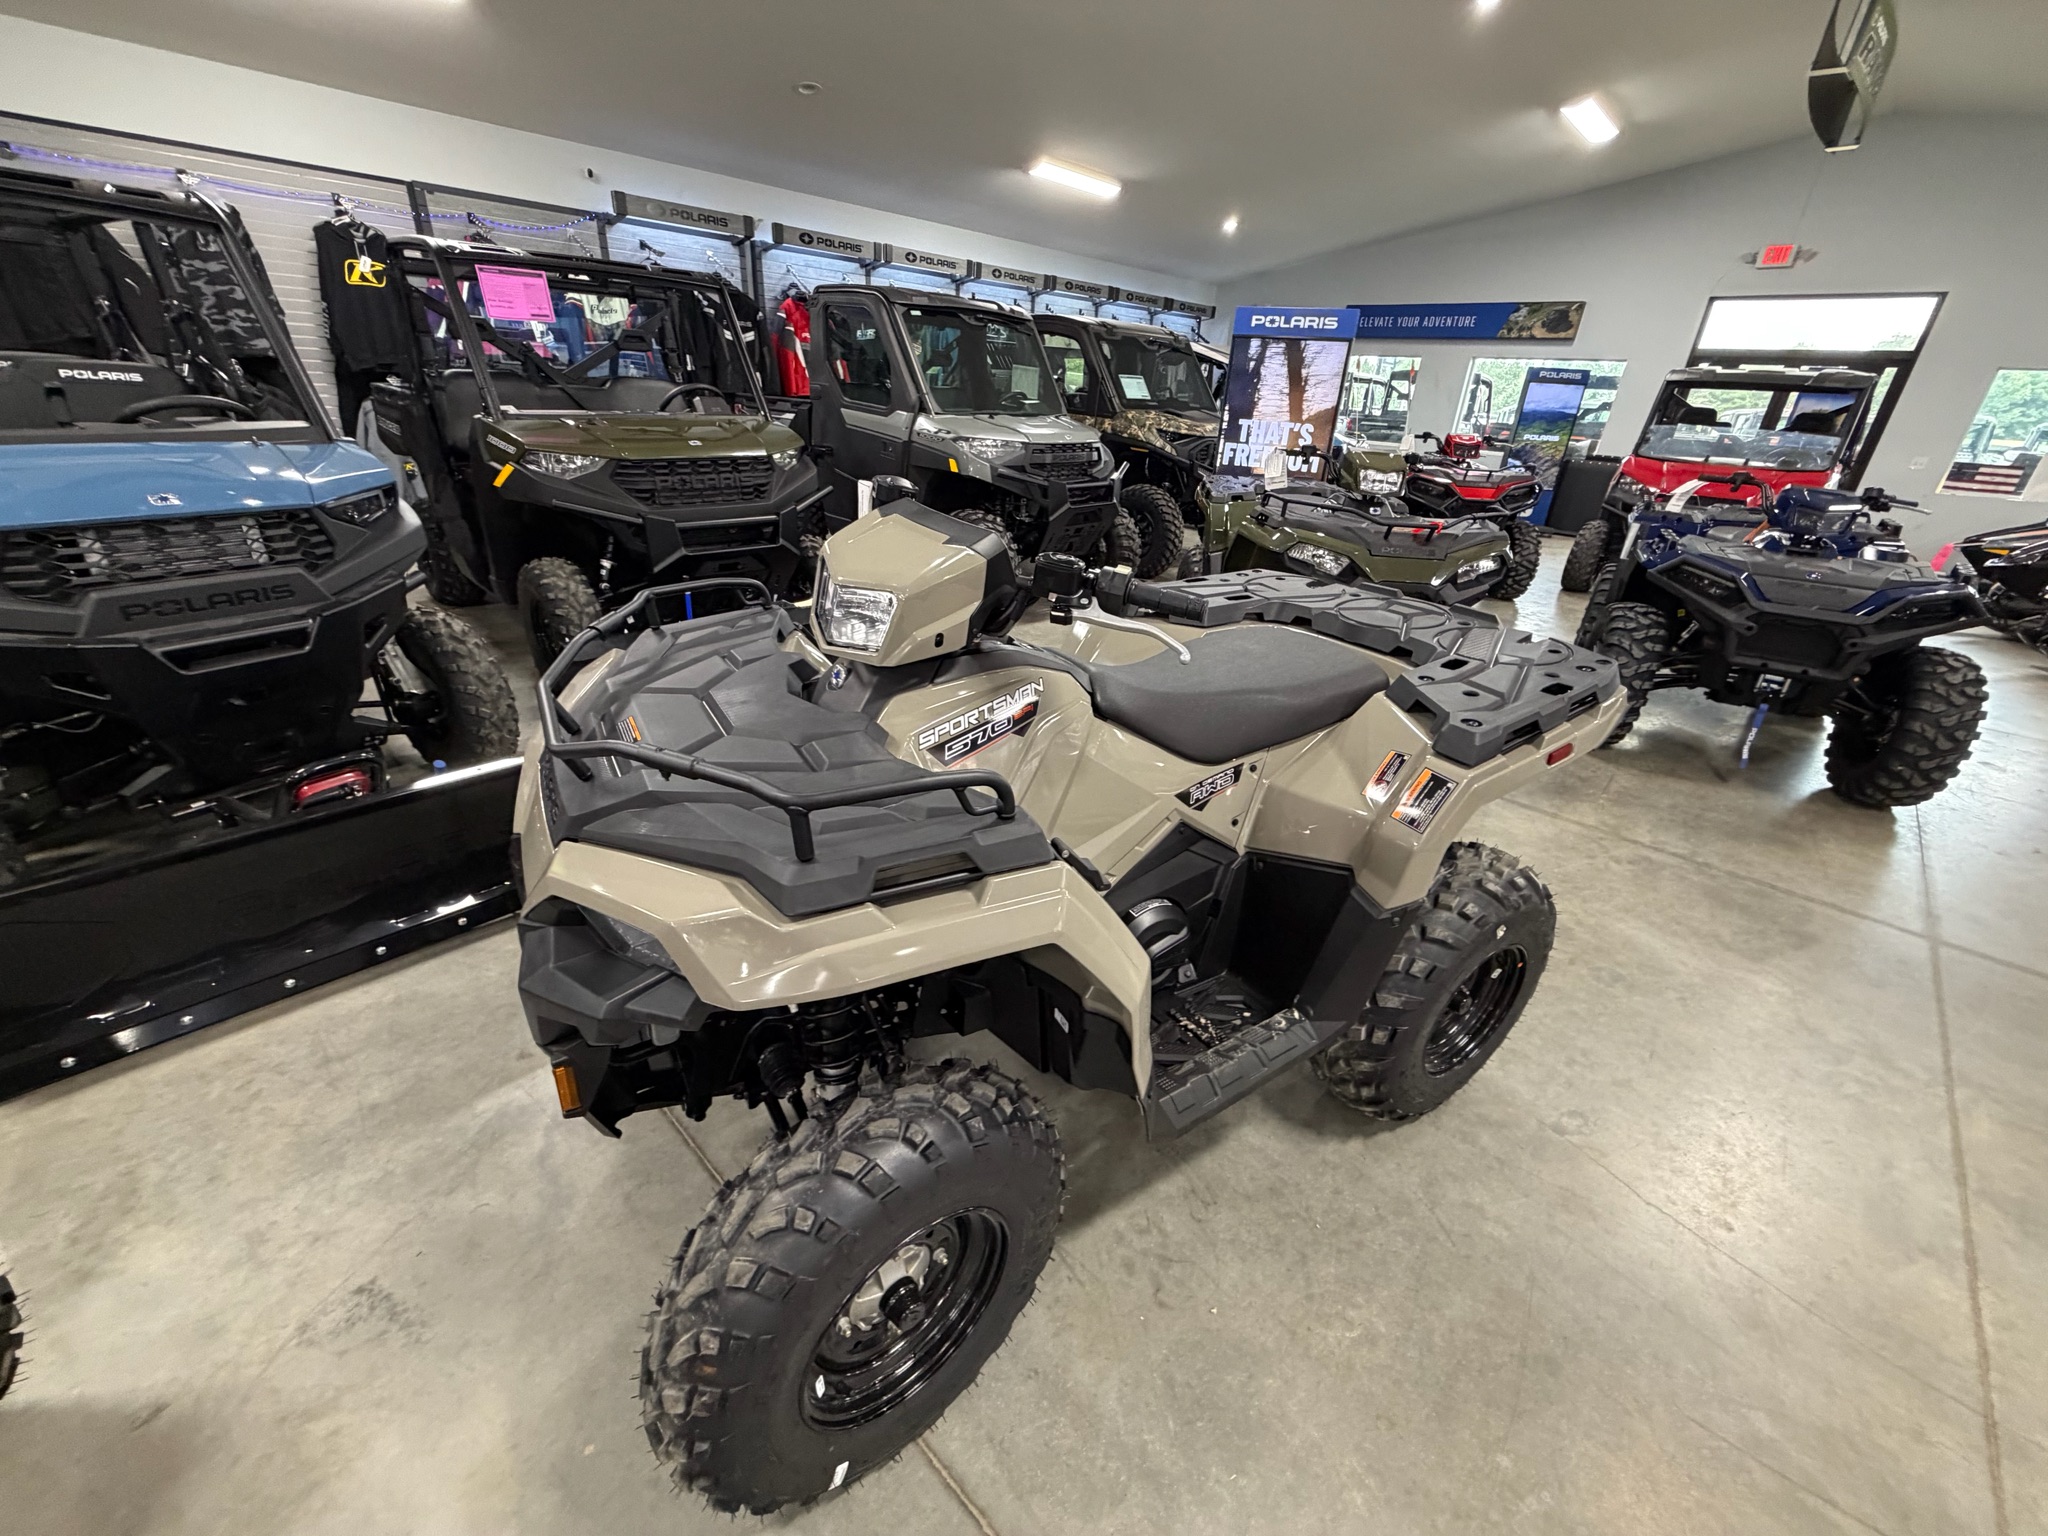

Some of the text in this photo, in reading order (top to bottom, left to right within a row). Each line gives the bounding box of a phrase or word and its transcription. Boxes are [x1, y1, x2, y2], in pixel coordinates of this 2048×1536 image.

[670, 208, 730, 228] POLARIS
[816, 236, 863, 253] POLARIS
[919, 255, 957, 270] POLARIS
[1003, 271, 1036, 284] POLARIS
[1074, 283, 1102, 295] POLARIS
[1250, 315, 1339, 330] POLARIS
[1359, 315, 1477, 328] ELEVATE YOUR ADVENTURE
[57, 368, 144, 382] POLARIS
[1539, 370, 1583, 380] POLARIS
[1238, 418, 1315, 447] THAT'S
[1523, 433, 1560, 442] POLARIS
[119, 583, 297, 622] POLARIS
[918, 677, 1044, 751] SPORTSMAN
[944, 715, 1013, 760] 570
[1189, 773, 1235, 805] AWD
